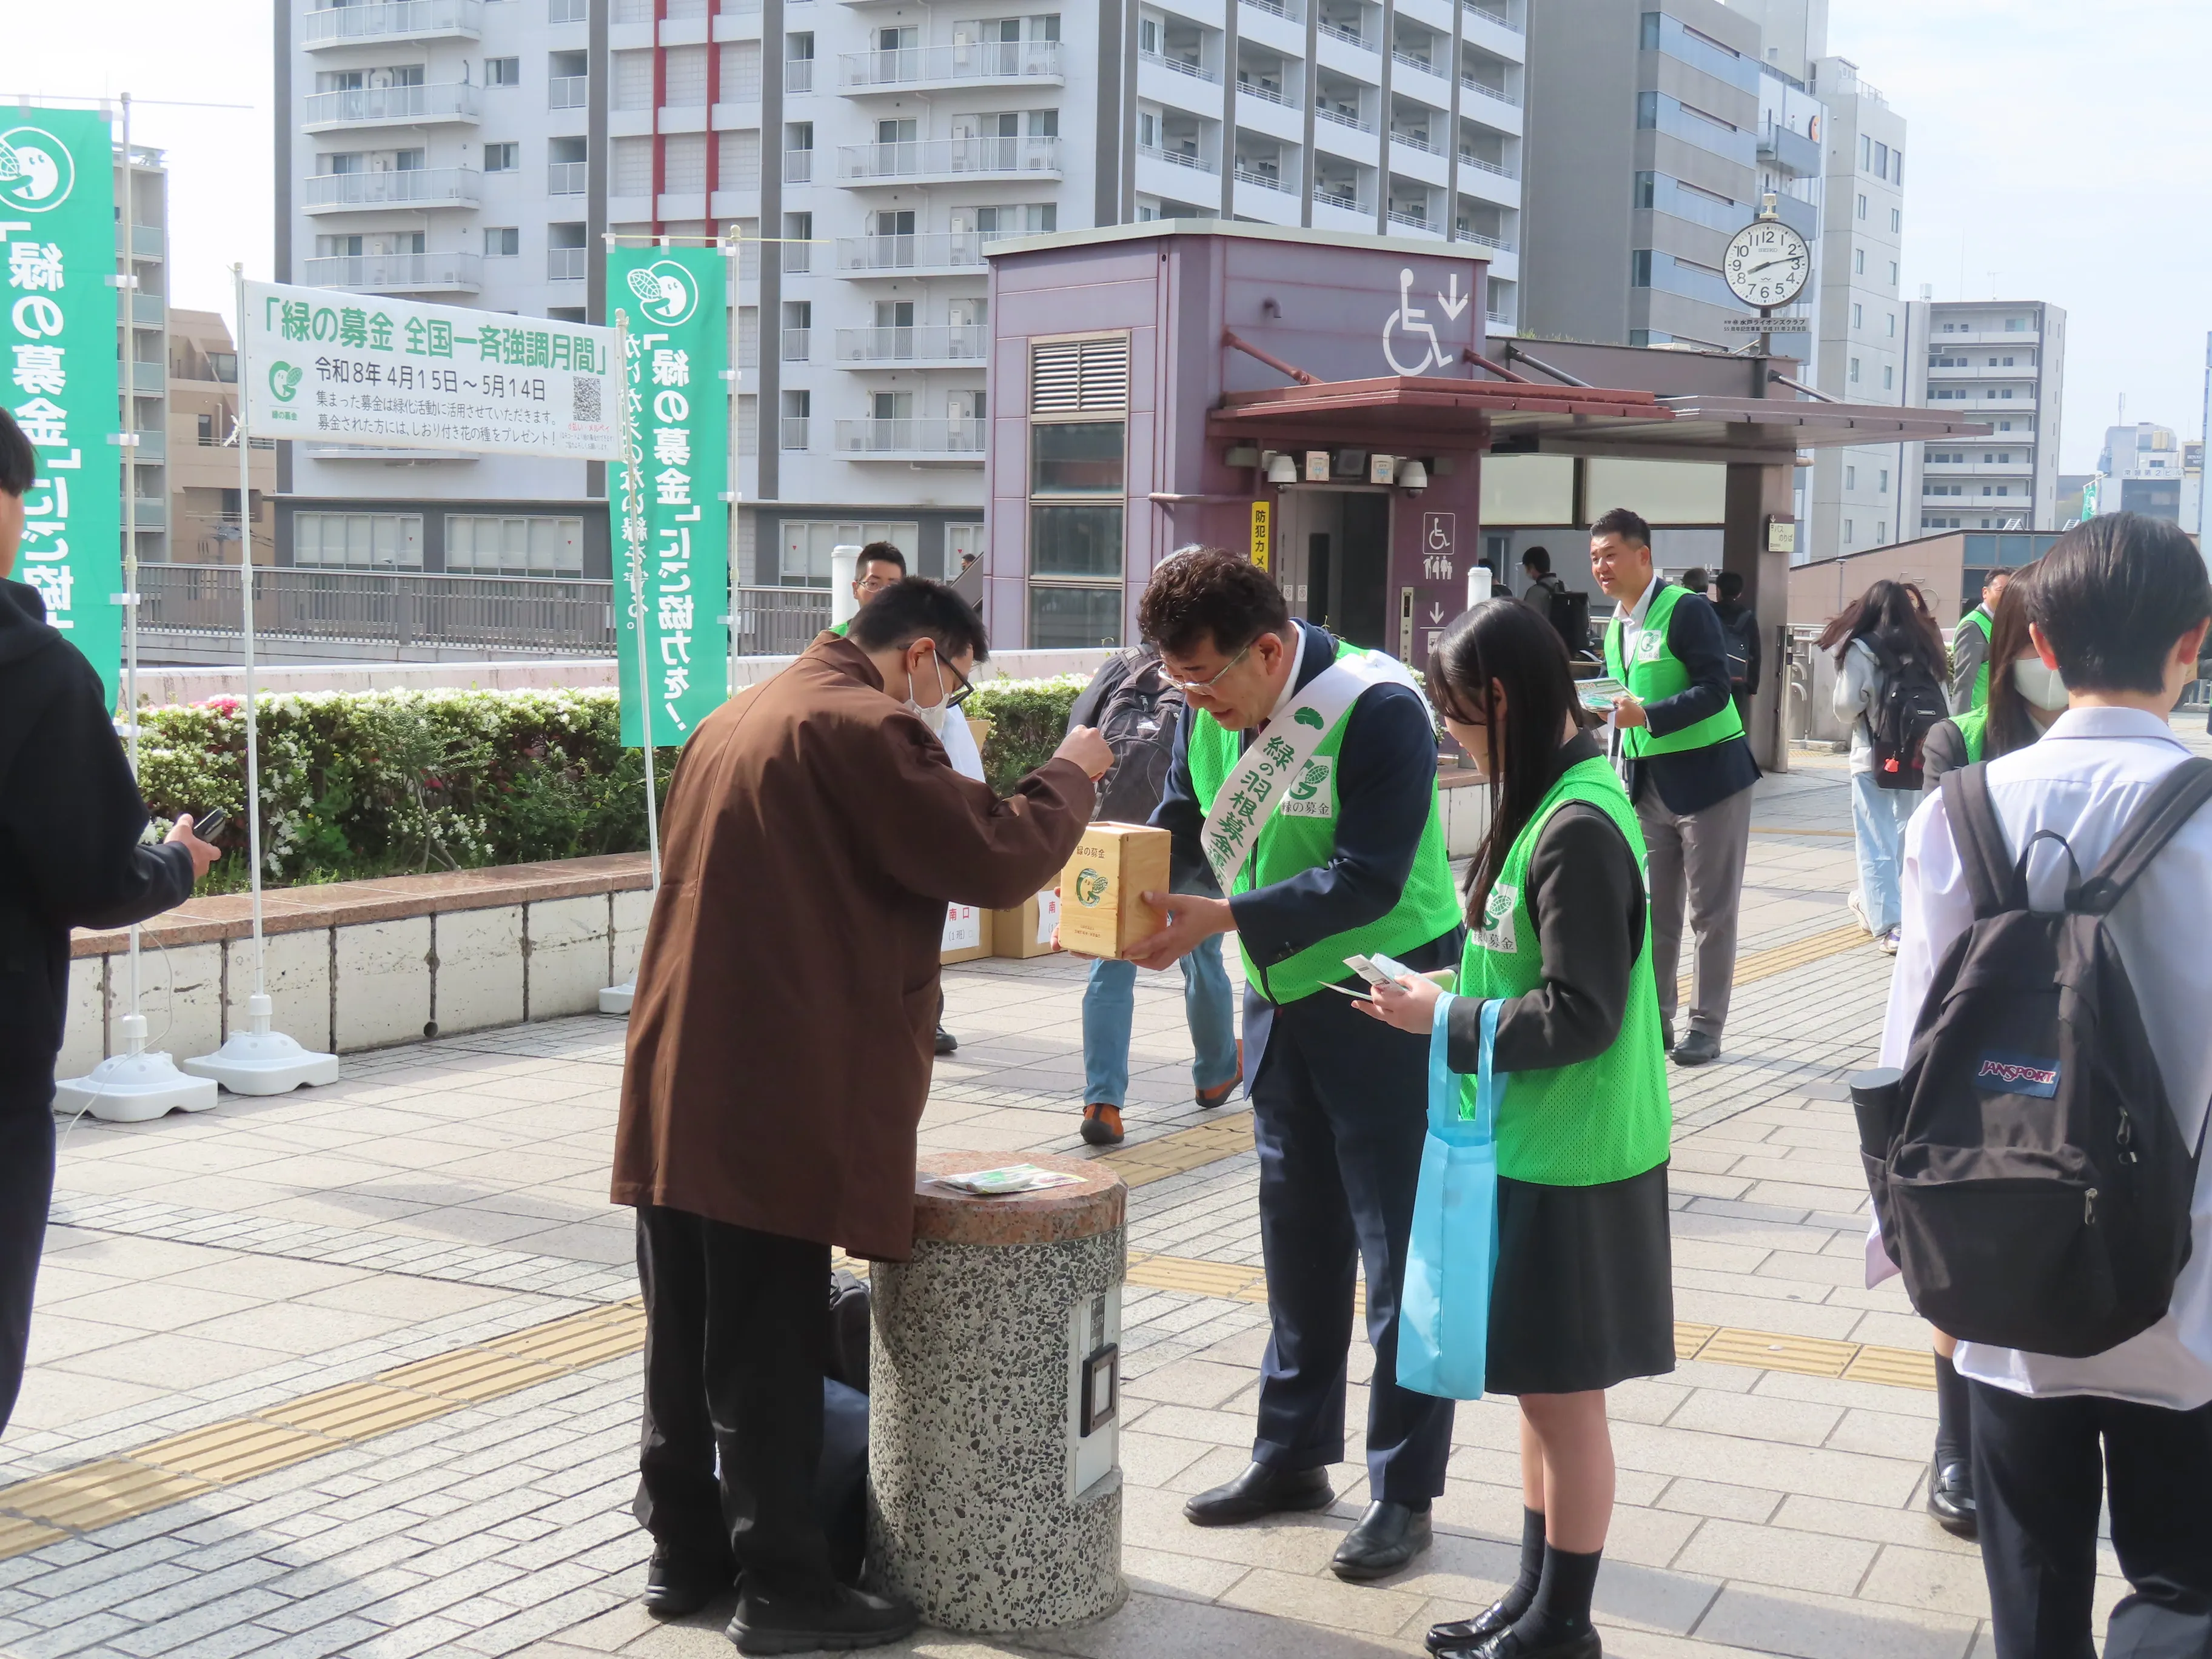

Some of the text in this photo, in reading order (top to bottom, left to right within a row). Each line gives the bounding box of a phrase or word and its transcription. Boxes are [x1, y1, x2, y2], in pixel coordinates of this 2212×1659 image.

[1749, 235, 1758, 246] 11
[1762, 232, 1774, 243] 12
[1737, 245, 1749, 257] 10
[1788, 244, 1797, 255] 2
[1732, 260, 1741, 271] 9
[1791, 258, 1800, 270] 3
[1737, 272, 1746, 284] 8
[1786, 272, 1795, 284] 4
[1748, 284, 1757, 295] 7
[1760, 286, 1769, 298] 6
[1775, 283, 1784, 295] 5
[266, 297, 607, 375] 「緑の募金 全国一斉強調月間」
[316, 390, 555, 426] 集まった募金は緑化活動に活用させていただきます。
[272, 410, 298, 421] 緑の募金
[318, 414, 555, 446] 募金された方には、しおり付き花の種をプレゼント！
[1255, 510, 1266, 569] 防犯カメ
[1282, 800, 1330, 816] 緑の募金
[1077, 845, 1105, 859] 緑の募金
[1979, 1061, 2057, 1084] JANSPORT
